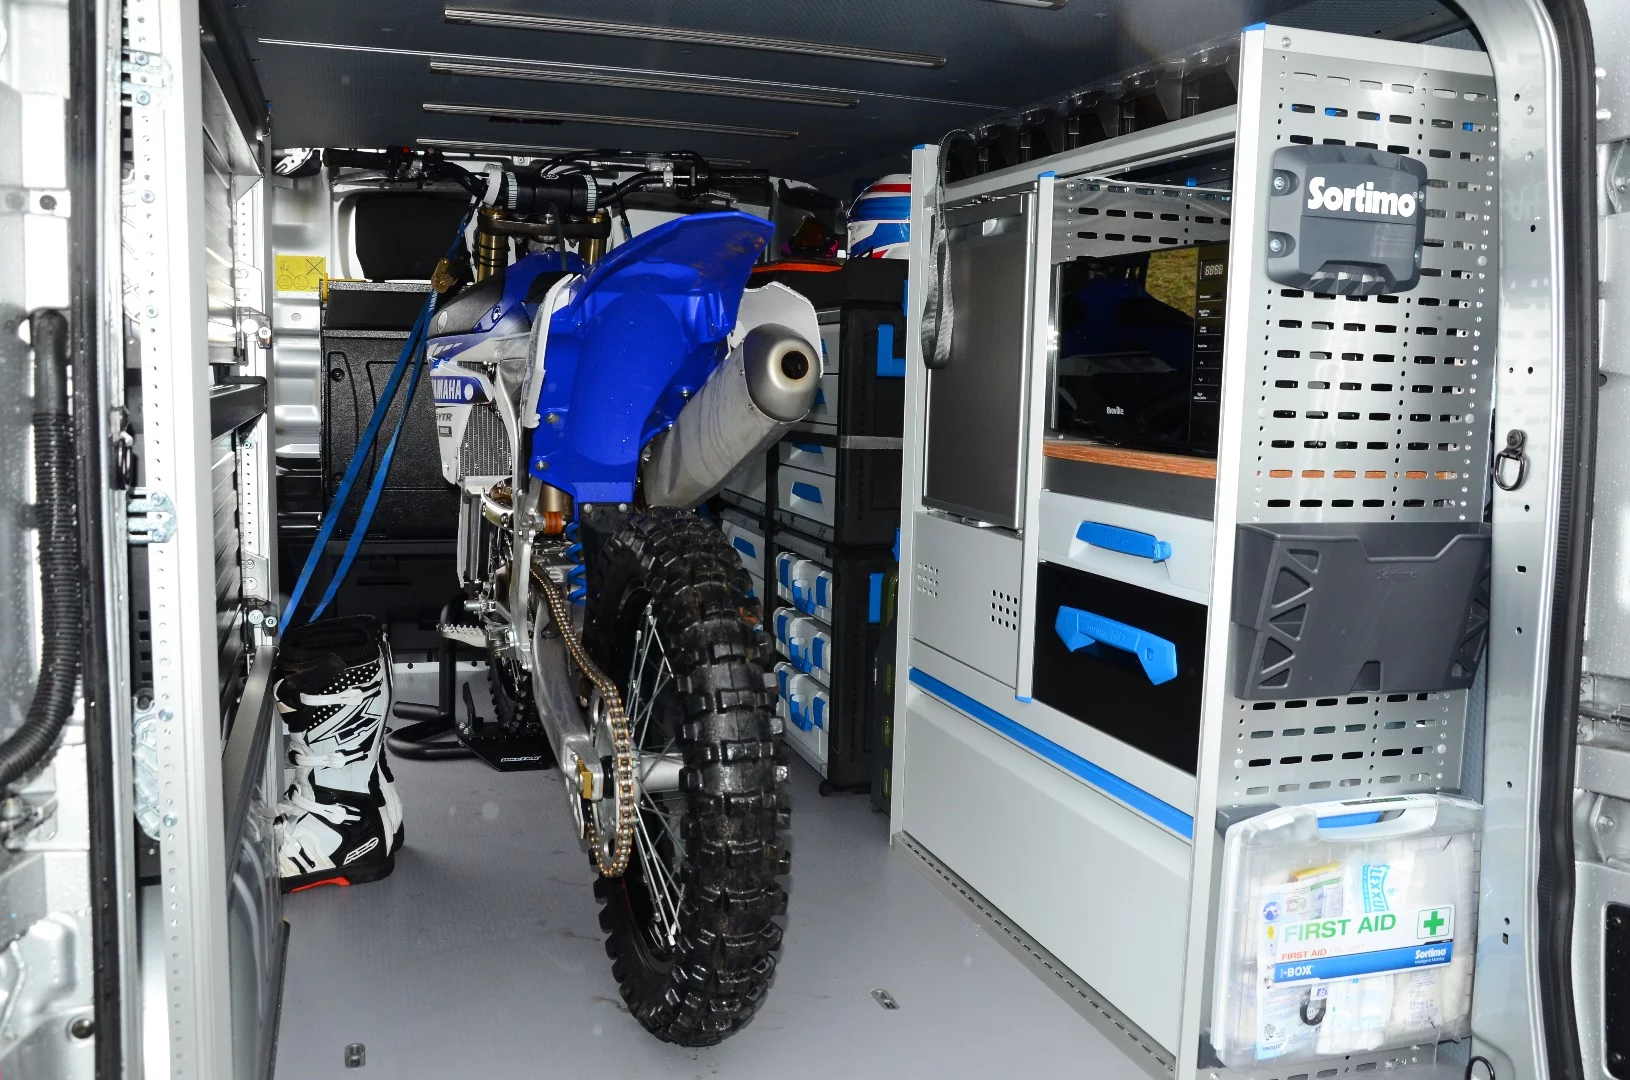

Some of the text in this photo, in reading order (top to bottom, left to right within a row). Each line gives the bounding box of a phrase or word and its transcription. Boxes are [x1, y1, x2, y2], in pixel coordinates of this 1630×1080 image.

[1307, 176, 1416, 217] Sortimo
[1284, 914, 1397, 943] FIRST AID
[1281, 951, 1308, 961] FIRST
[1310, 948, 1327, 957] AID
[1414, 948, 1447, 960] Sortimo
